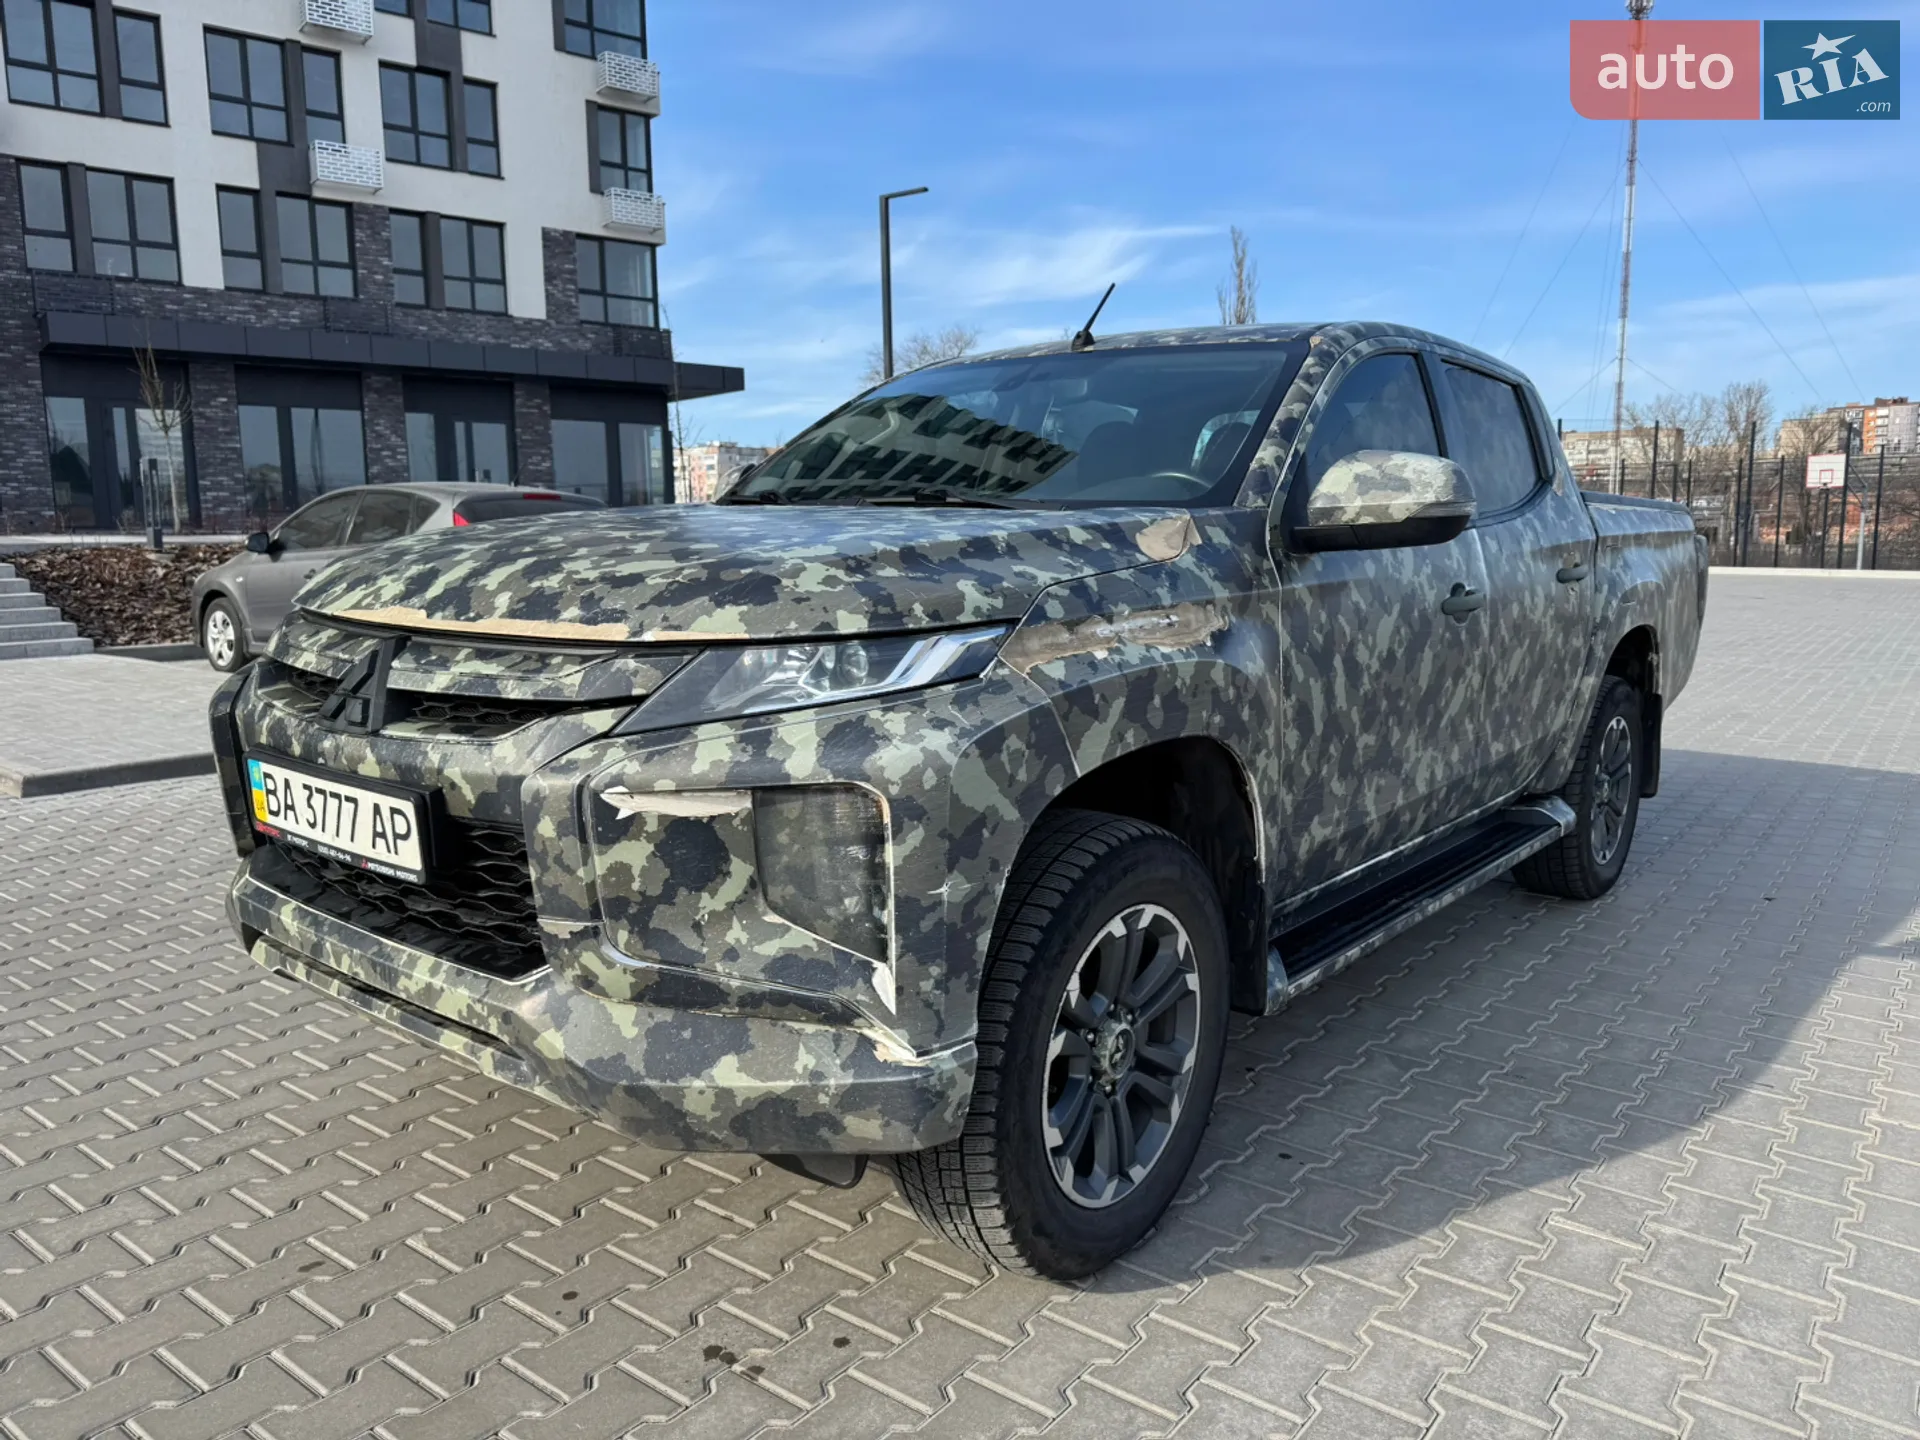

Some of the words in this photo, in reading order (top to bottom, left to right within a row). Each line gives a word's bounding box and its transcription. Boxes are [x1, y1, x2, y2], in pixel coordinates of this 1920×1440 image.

[262, 771, 299, 825] BA
[302, 783, 359, 843] 3777
[371, 802, 412, 856] AP
